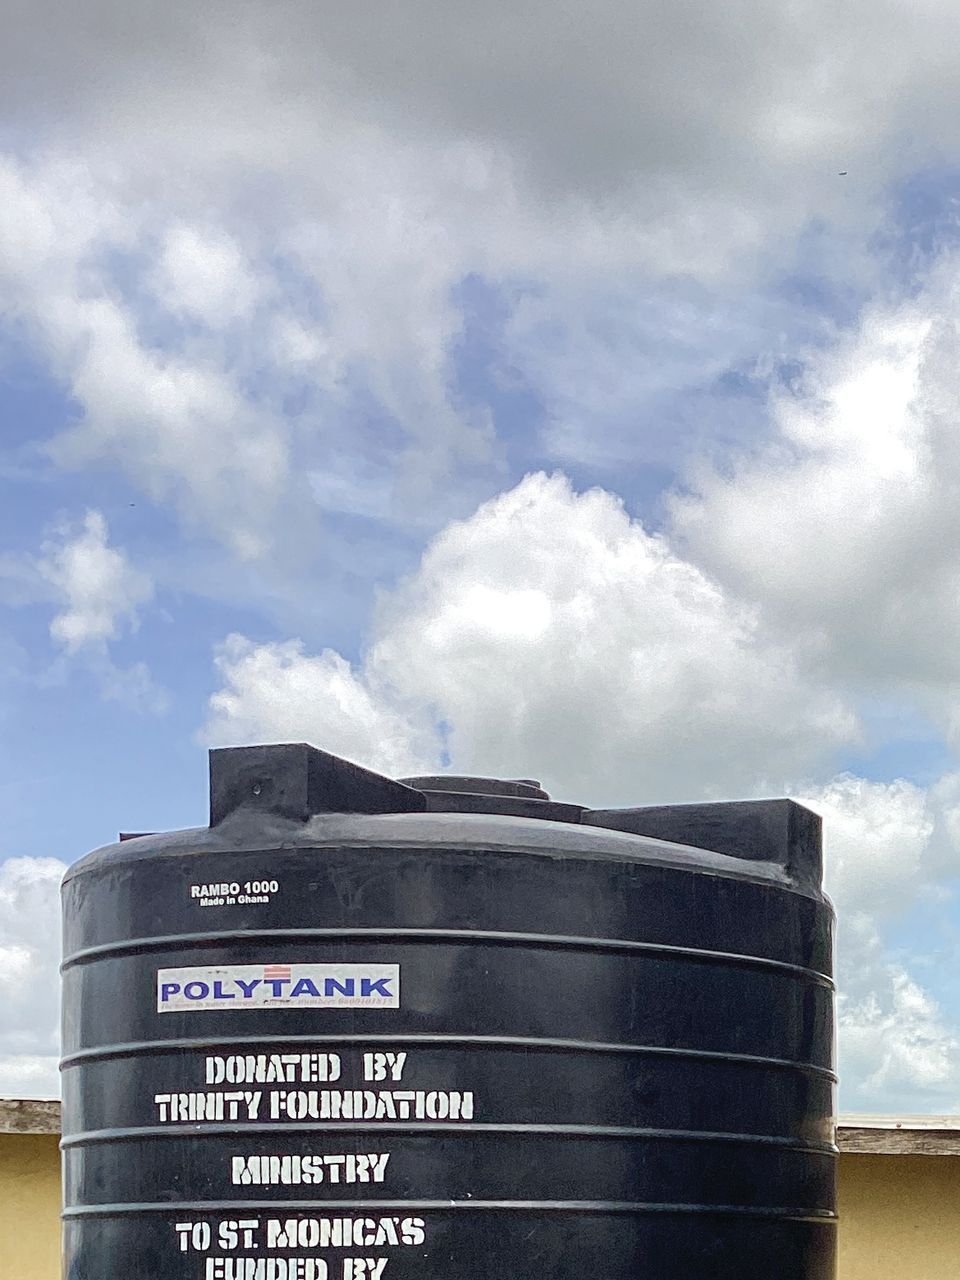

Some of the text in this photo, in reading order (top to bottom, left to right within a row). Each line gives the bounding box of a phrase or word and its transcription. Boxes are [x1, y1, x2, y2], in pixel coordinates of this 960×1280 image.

[190, 880, 279, 898] RAMBO 1000
[200, 895, 269, 907] Made in Ghana
[161, 977, 394, 1002] POLYTANK
[205, 1052, 408, 1085] DONATED BY
[154, 1089, 474, 1122] TRINITY FOUNDATION
[231, 1152, 390, 1185] MINISTRY
[175, 1217, 426, 1252] TO ST. MONICA'S
